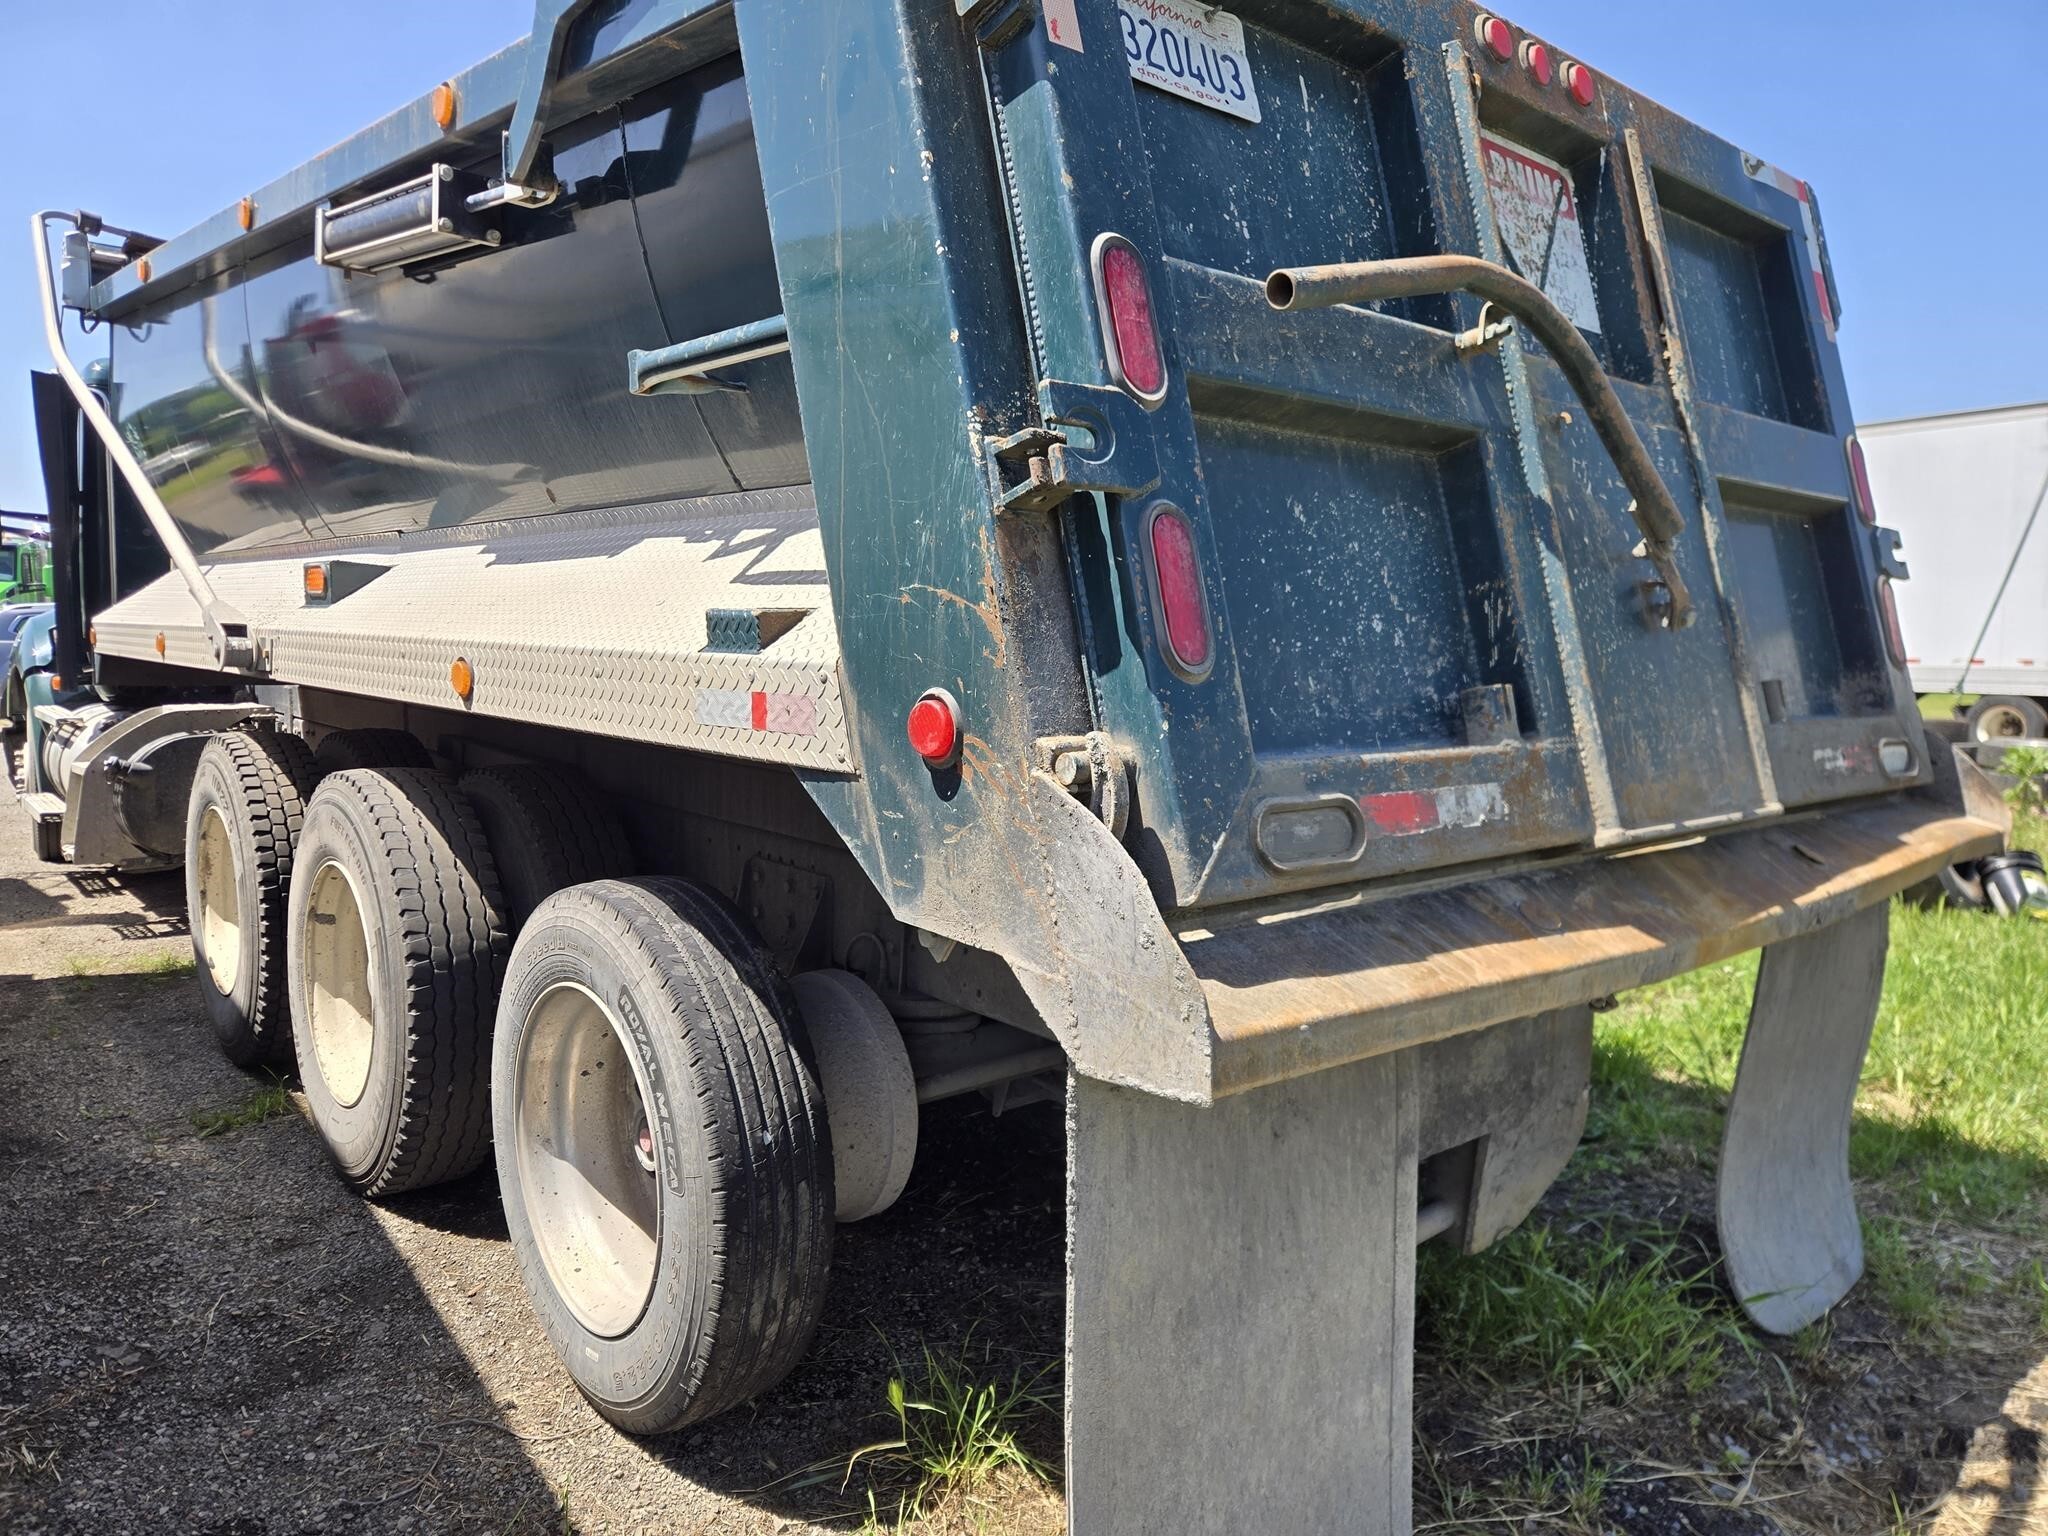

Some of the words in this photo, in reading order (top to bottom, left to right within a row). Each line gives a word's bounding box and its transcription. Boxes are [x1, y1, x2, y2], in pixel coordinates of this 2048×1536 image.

[1137, 67, 1222, 103] dmv.ca.gov
[620, 993, 656, 1082] ROYAL
[655, 1091, 680, 1189] MEGA
